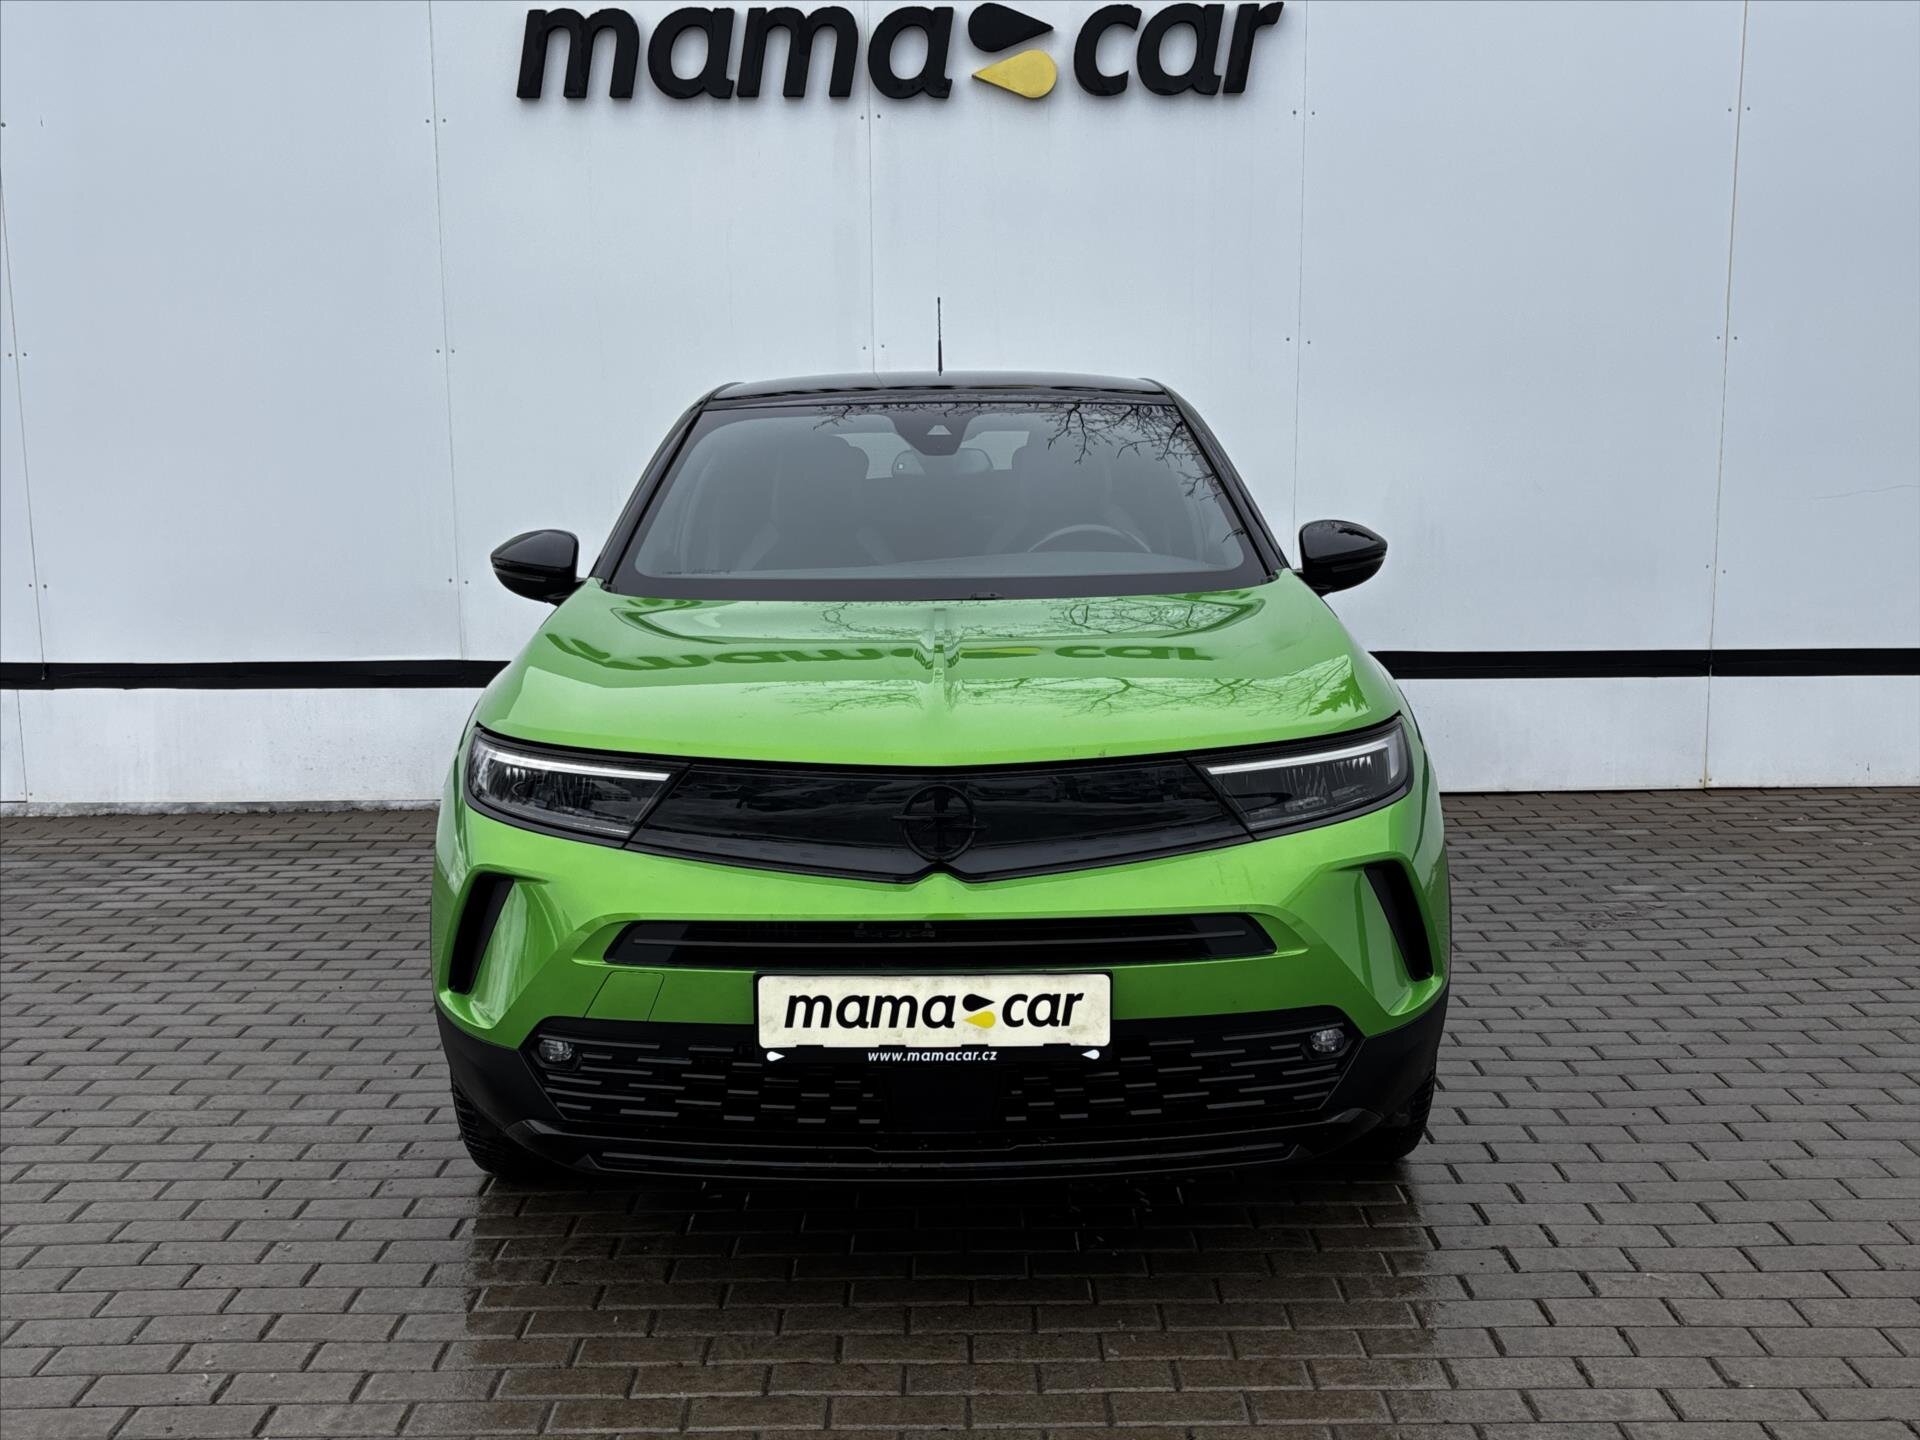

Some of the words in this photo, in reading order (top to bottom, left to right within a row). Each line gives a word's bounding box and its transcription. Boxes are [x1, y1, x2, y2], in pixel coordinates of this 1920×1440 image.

[517, 5, 955, 102] mama
[1073, 1, 1285, 100] car
[784, 994, 956, 1029] mama
[1001, 992, 1085, 1028] car
[867, 1051, 998, 1062] www.mamacar.cz
